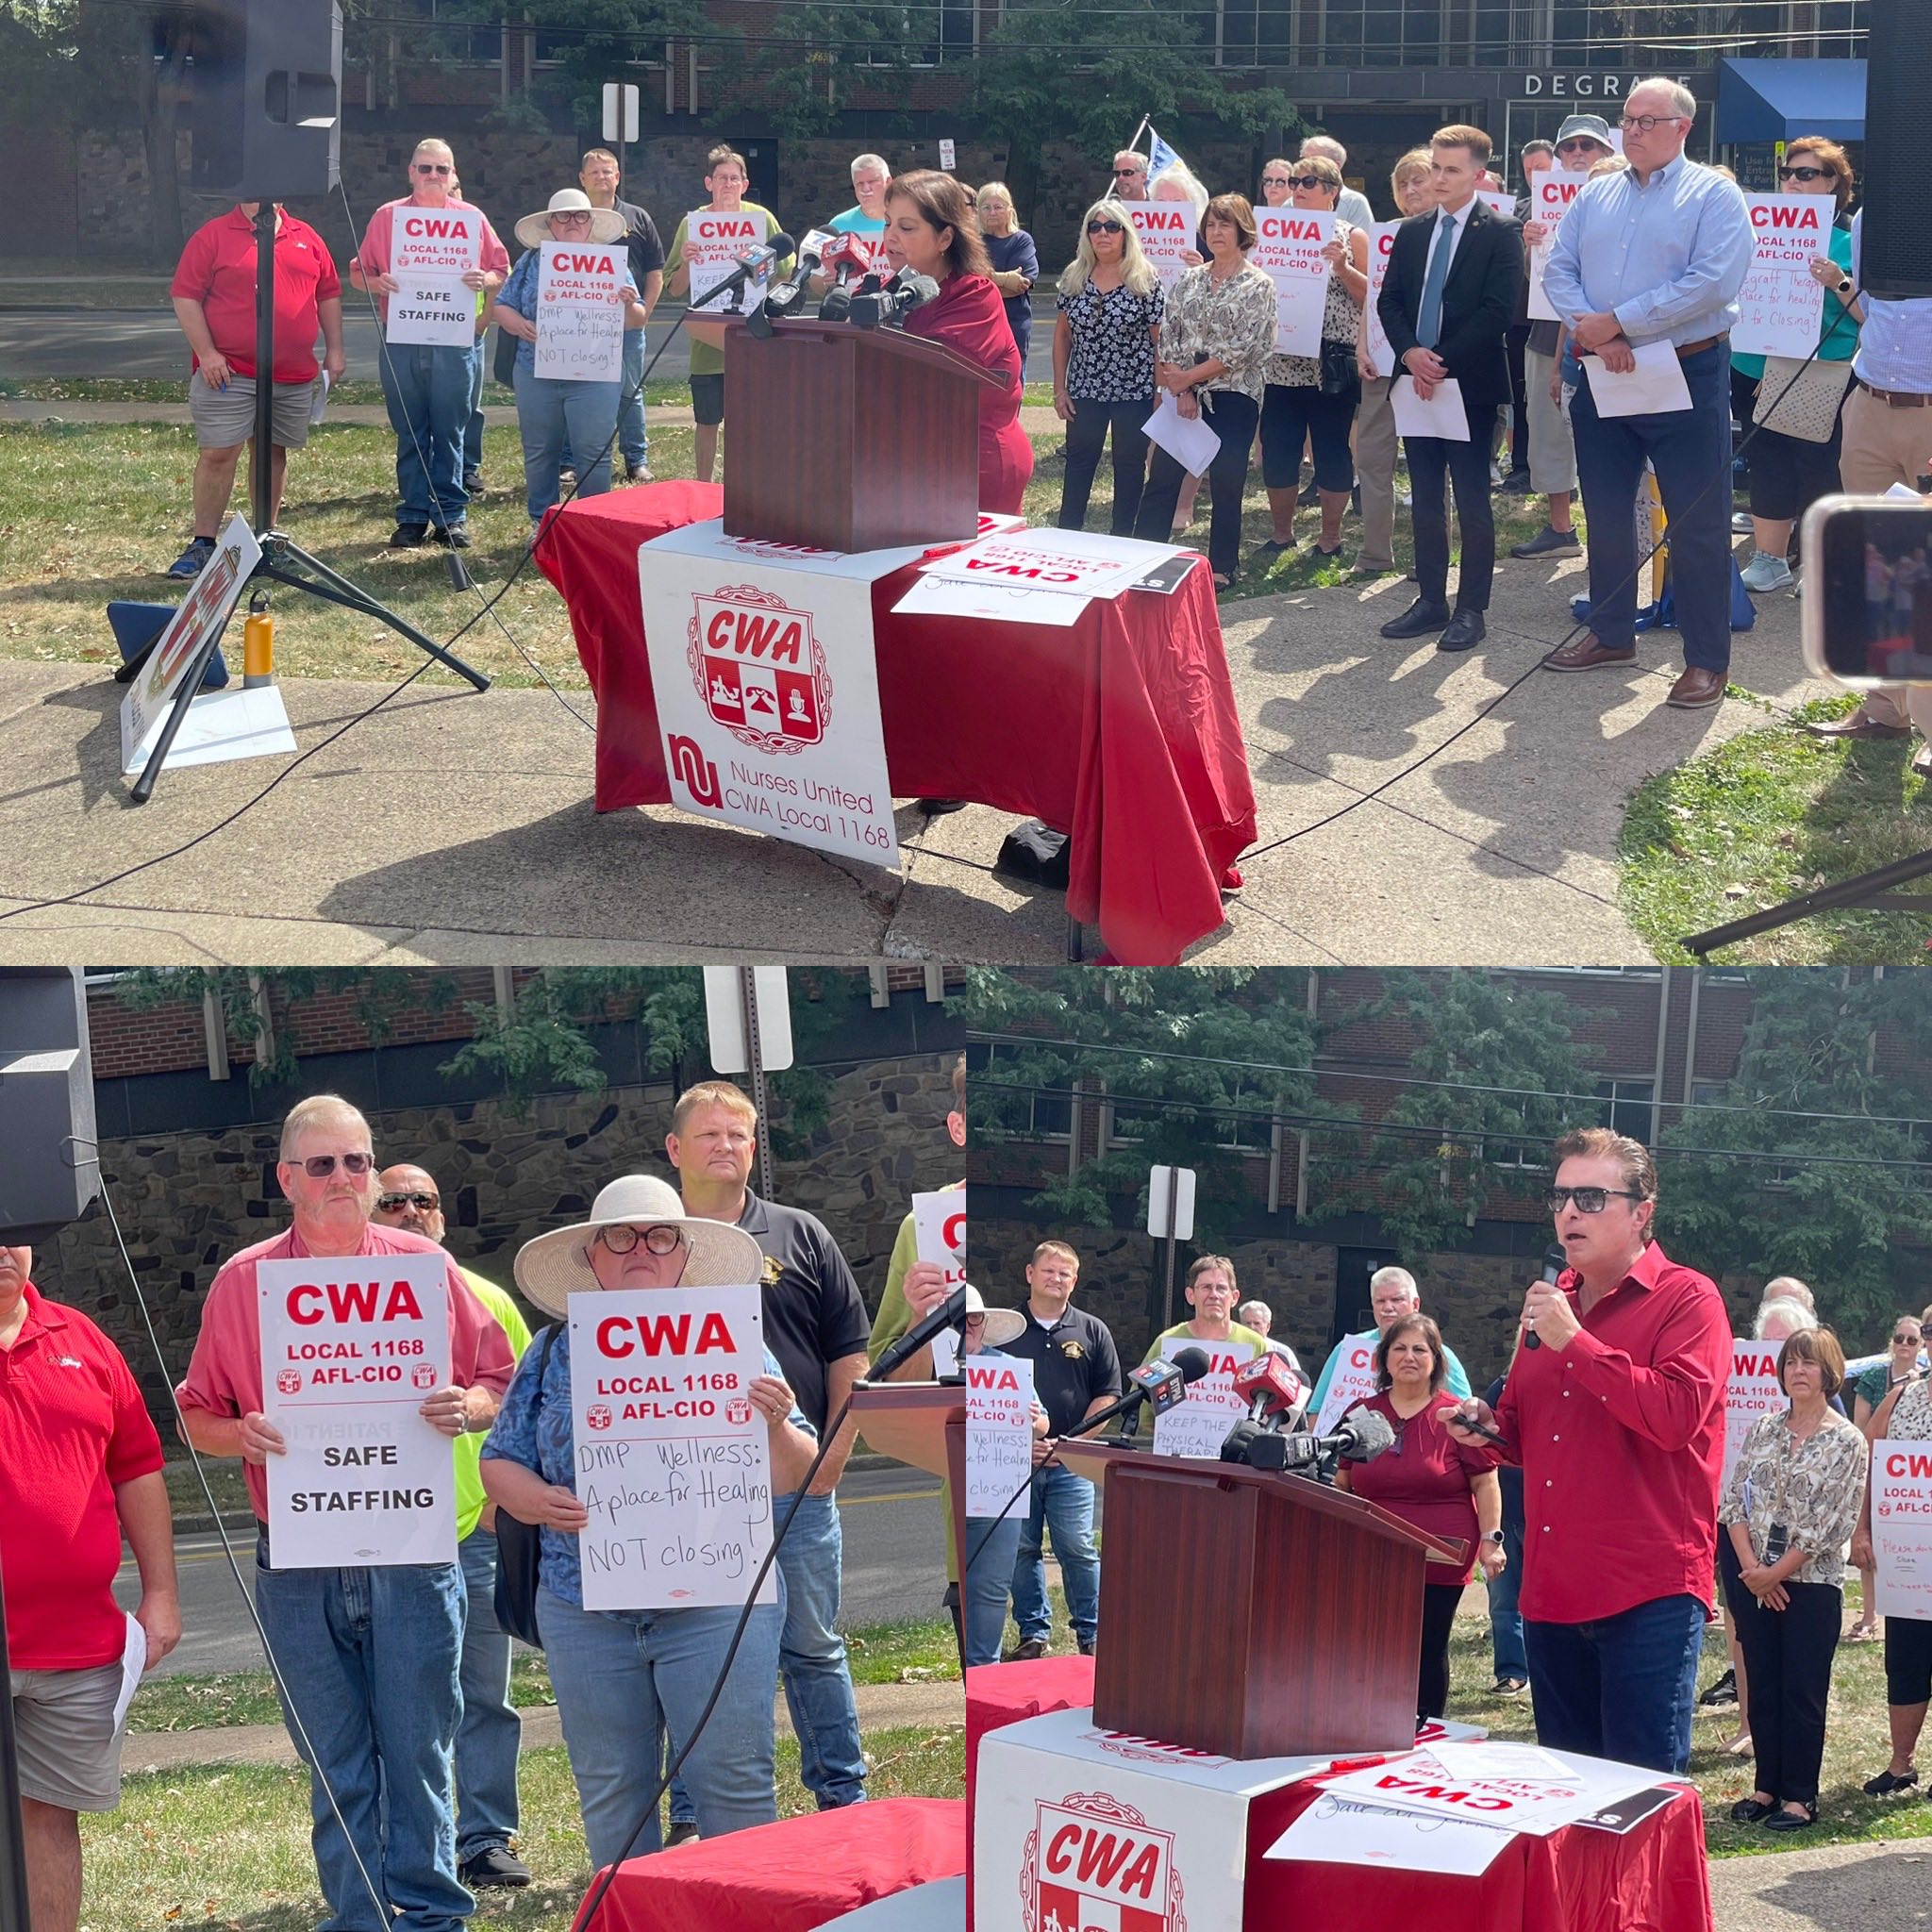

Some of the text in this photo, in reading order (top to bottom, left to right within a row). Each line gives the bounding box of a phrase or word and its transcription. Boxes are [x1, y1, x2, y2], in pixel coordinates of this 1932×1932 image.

[1525, 75, 1691, 95] DEGRAF
[1542, 183, 1584, 203] CW
[1131, 211, 1185, 230] CWA
[1541, 211, 1562, 220] LOC
[1751, 206, 1819, 229] CWA
[406, 218, 469, 240] CWA
[699, 221, 756, 238] CWA
[1262, 218, 1322, 242] CWA
[1141, 237, 1159, 245] CAL
[1790, 238, 1817, 247] 1168
[404, 245, 468, 256] LOCAL 1168
[708, 253, 737, 261] AFL-C
[1142, 248, 1175, 257] FL-CIO
[1258, 245, 1320, 258] LOCAL 1168
[1757, 249, 1804, 260] AFL-CIO
[413, 256, 457, 266] AFL-CIO
[552, 253, 615, 275] CWA
[1267, 258, 1307, 269] AFL-CIO
[550, 279, 615, 291] LOCAL 1168
[416, 291, 451, 302] SAFE
[560, 291, 603, 300] AFL-CIO
[398, 309, 466, 323] STAFFING
[539, 348, 566, 363] NOT
[1014, 551, 1091, 565] AFL-CIO
[1036, 560, 1099, 573] LOCAL
[966, 558, 1079, 583] CWA
[708, 609, 802, 664] CWA
[730, 761, 874, 815] Nurses United
[725, 789, 891, 849] CWA Local 1168
[286, 1280, 424, 1325] CWA
[596, 1312, 738, 1359] CWA
[287, 1340, 425, 1360] LOCAL 1168
[415, 1366, 432, 1374] CWA
[1734, 1355, 1778, 1377] WA
[279, 1372, 297, 1381] CWA
[311, 1366, 402, 1385] AFL-CIO
[968, 1368, 1019, 1391] WA
[596, 1374, 738, 1396] LOCAL 1168
[1726, 1386, 1777, 1396] CAL 1168
[622, 1400, 715, 1420] AFL-CIO
[990, 1399, 1019, 1408] 1168
[1726, 1399, 1766, 1409] AFL-CIO
[966, 1411, 1006, 1421] FL-CIO
[1164, 1415, 1228, 1432] KEEP THE
[1157, 1432, 1217, 1449] PHYSICAL
[324, 1445, 398, 1467] SAFE
[578, 1441, 630, 1473] DMP
[1887, 1454, 1932, 1479] CW
[291, 1488, 434, 1512] STAFFING
[585, 1470, 769, 1526] A place for Healing
[1884, 1487, 1924, 1498] LOCAL
[1895, 1502, 1932, 1513] AFL-C
[589, 1539, 647, 1573] NOT
[1374, 1774, 1513, 1811] CWA
[1470, 1781, 1544, 1801] LOCAL
[1047, 1824, 1160, 1900] CWA
